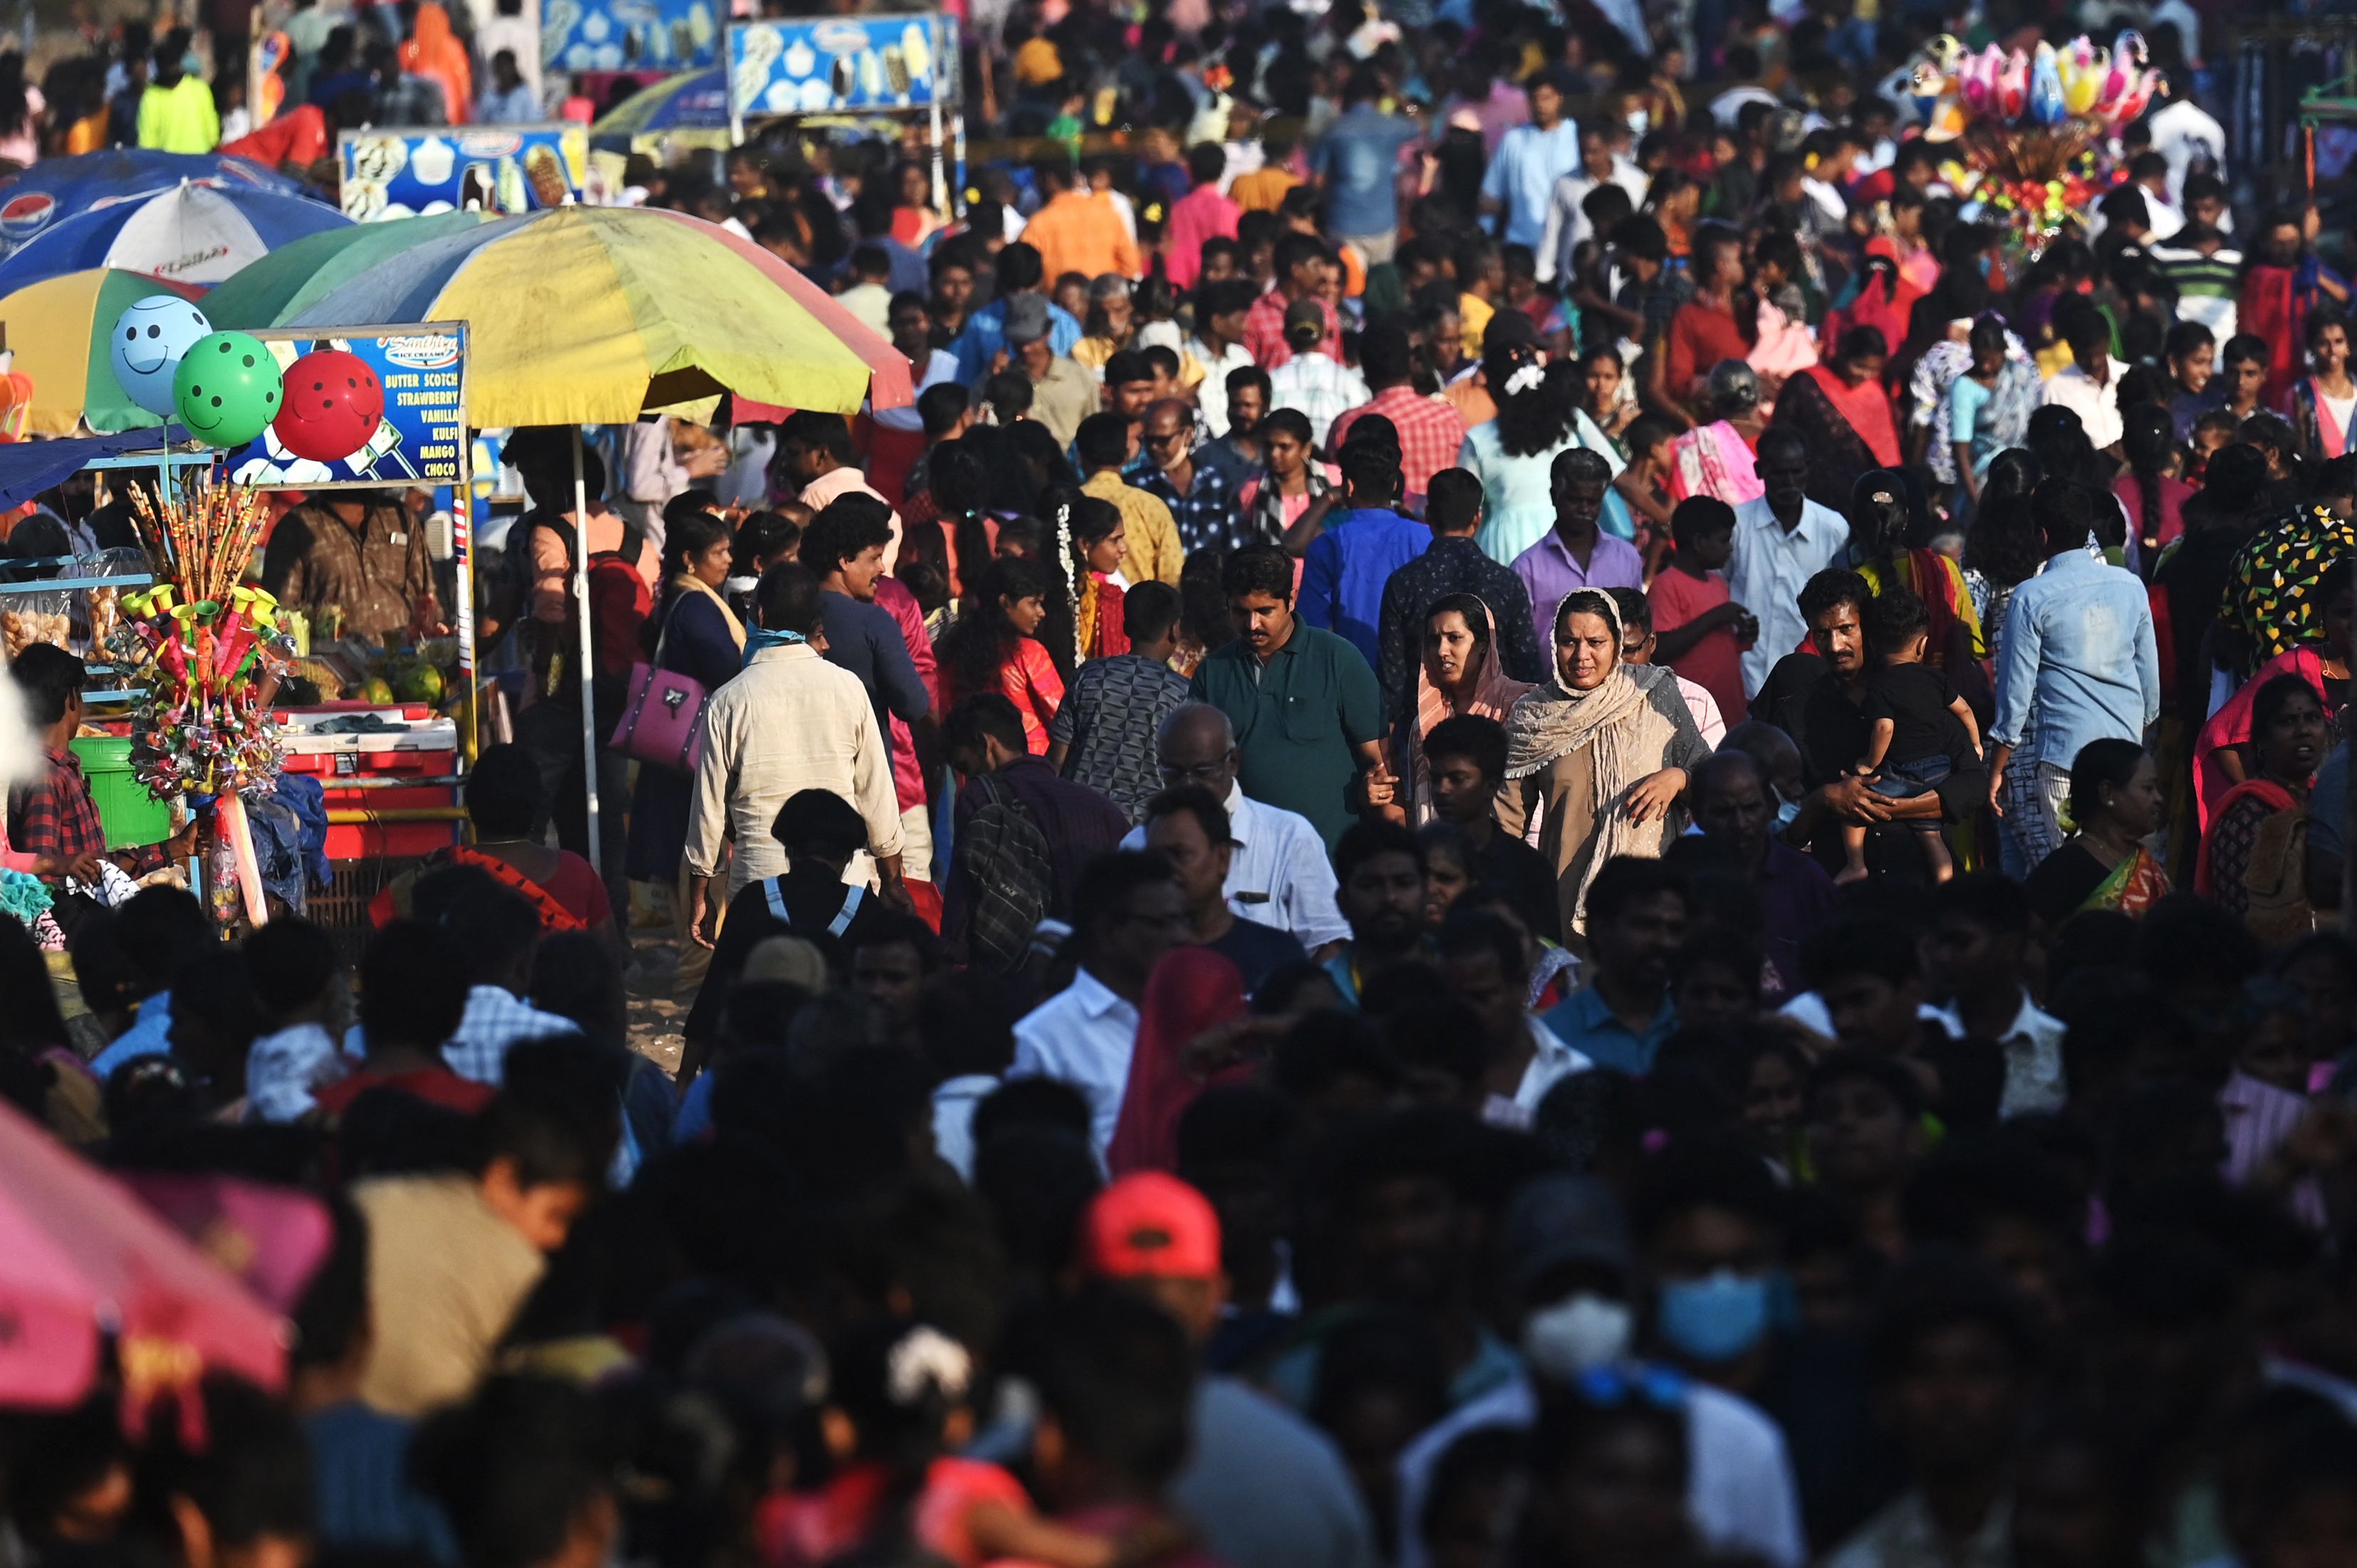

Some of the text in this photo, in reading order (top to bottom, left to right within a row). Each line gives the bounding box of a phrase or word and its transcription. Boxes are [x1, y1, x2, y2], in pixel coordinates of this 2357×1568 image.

[385, 372, 458, 389] BUTTER SCOTCH
[397, 390, 459, 406] STRAWBERRY
[420, 409, 459, 424] VANILLA
[432, 427, 458, 441] KULFI
[420, 444, 456, 460] MANGO
[425, 462, 456, 477] CHOCO
